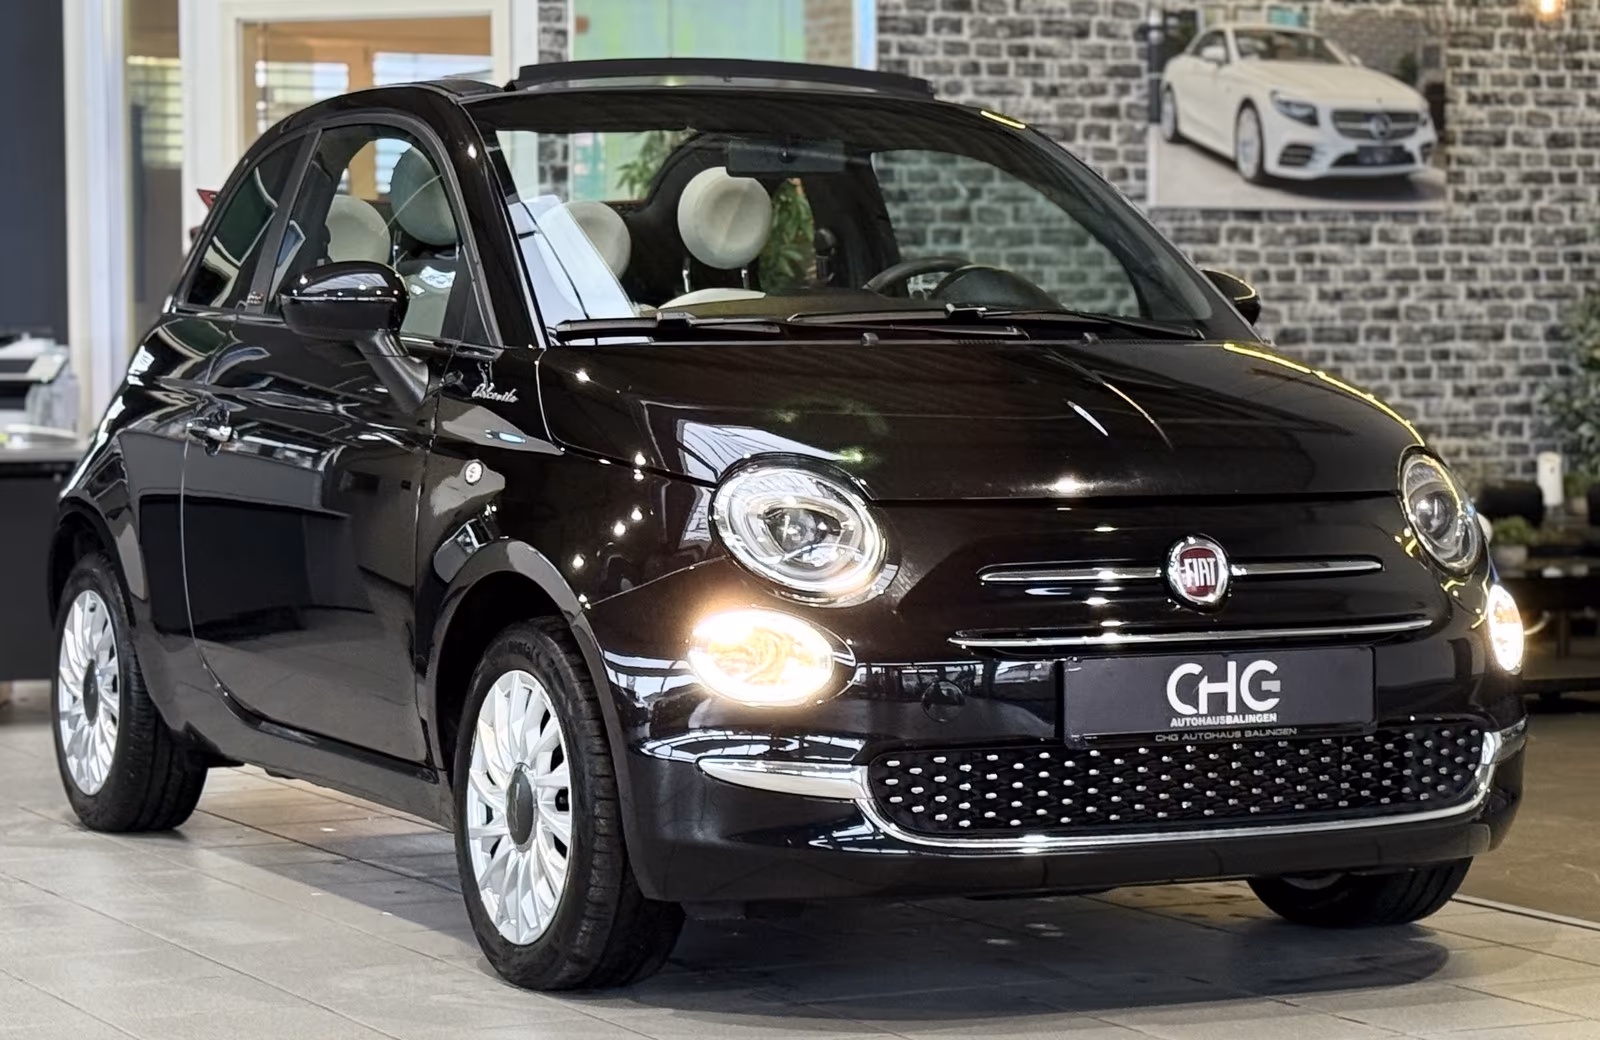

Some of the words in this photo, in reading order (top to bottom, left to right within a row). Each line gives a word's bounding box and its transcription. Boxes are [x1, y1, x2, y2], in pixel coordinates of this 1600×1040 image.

[1183, 557, 1216, 587] FIAT
[1166, 660, 1281, 715] CHG
[1155, 733, 1179, 742] CHG
[1182, 731, 1241, 741] AUTOHAUS
[1244, 727, 1298, 738] BALINGEN
